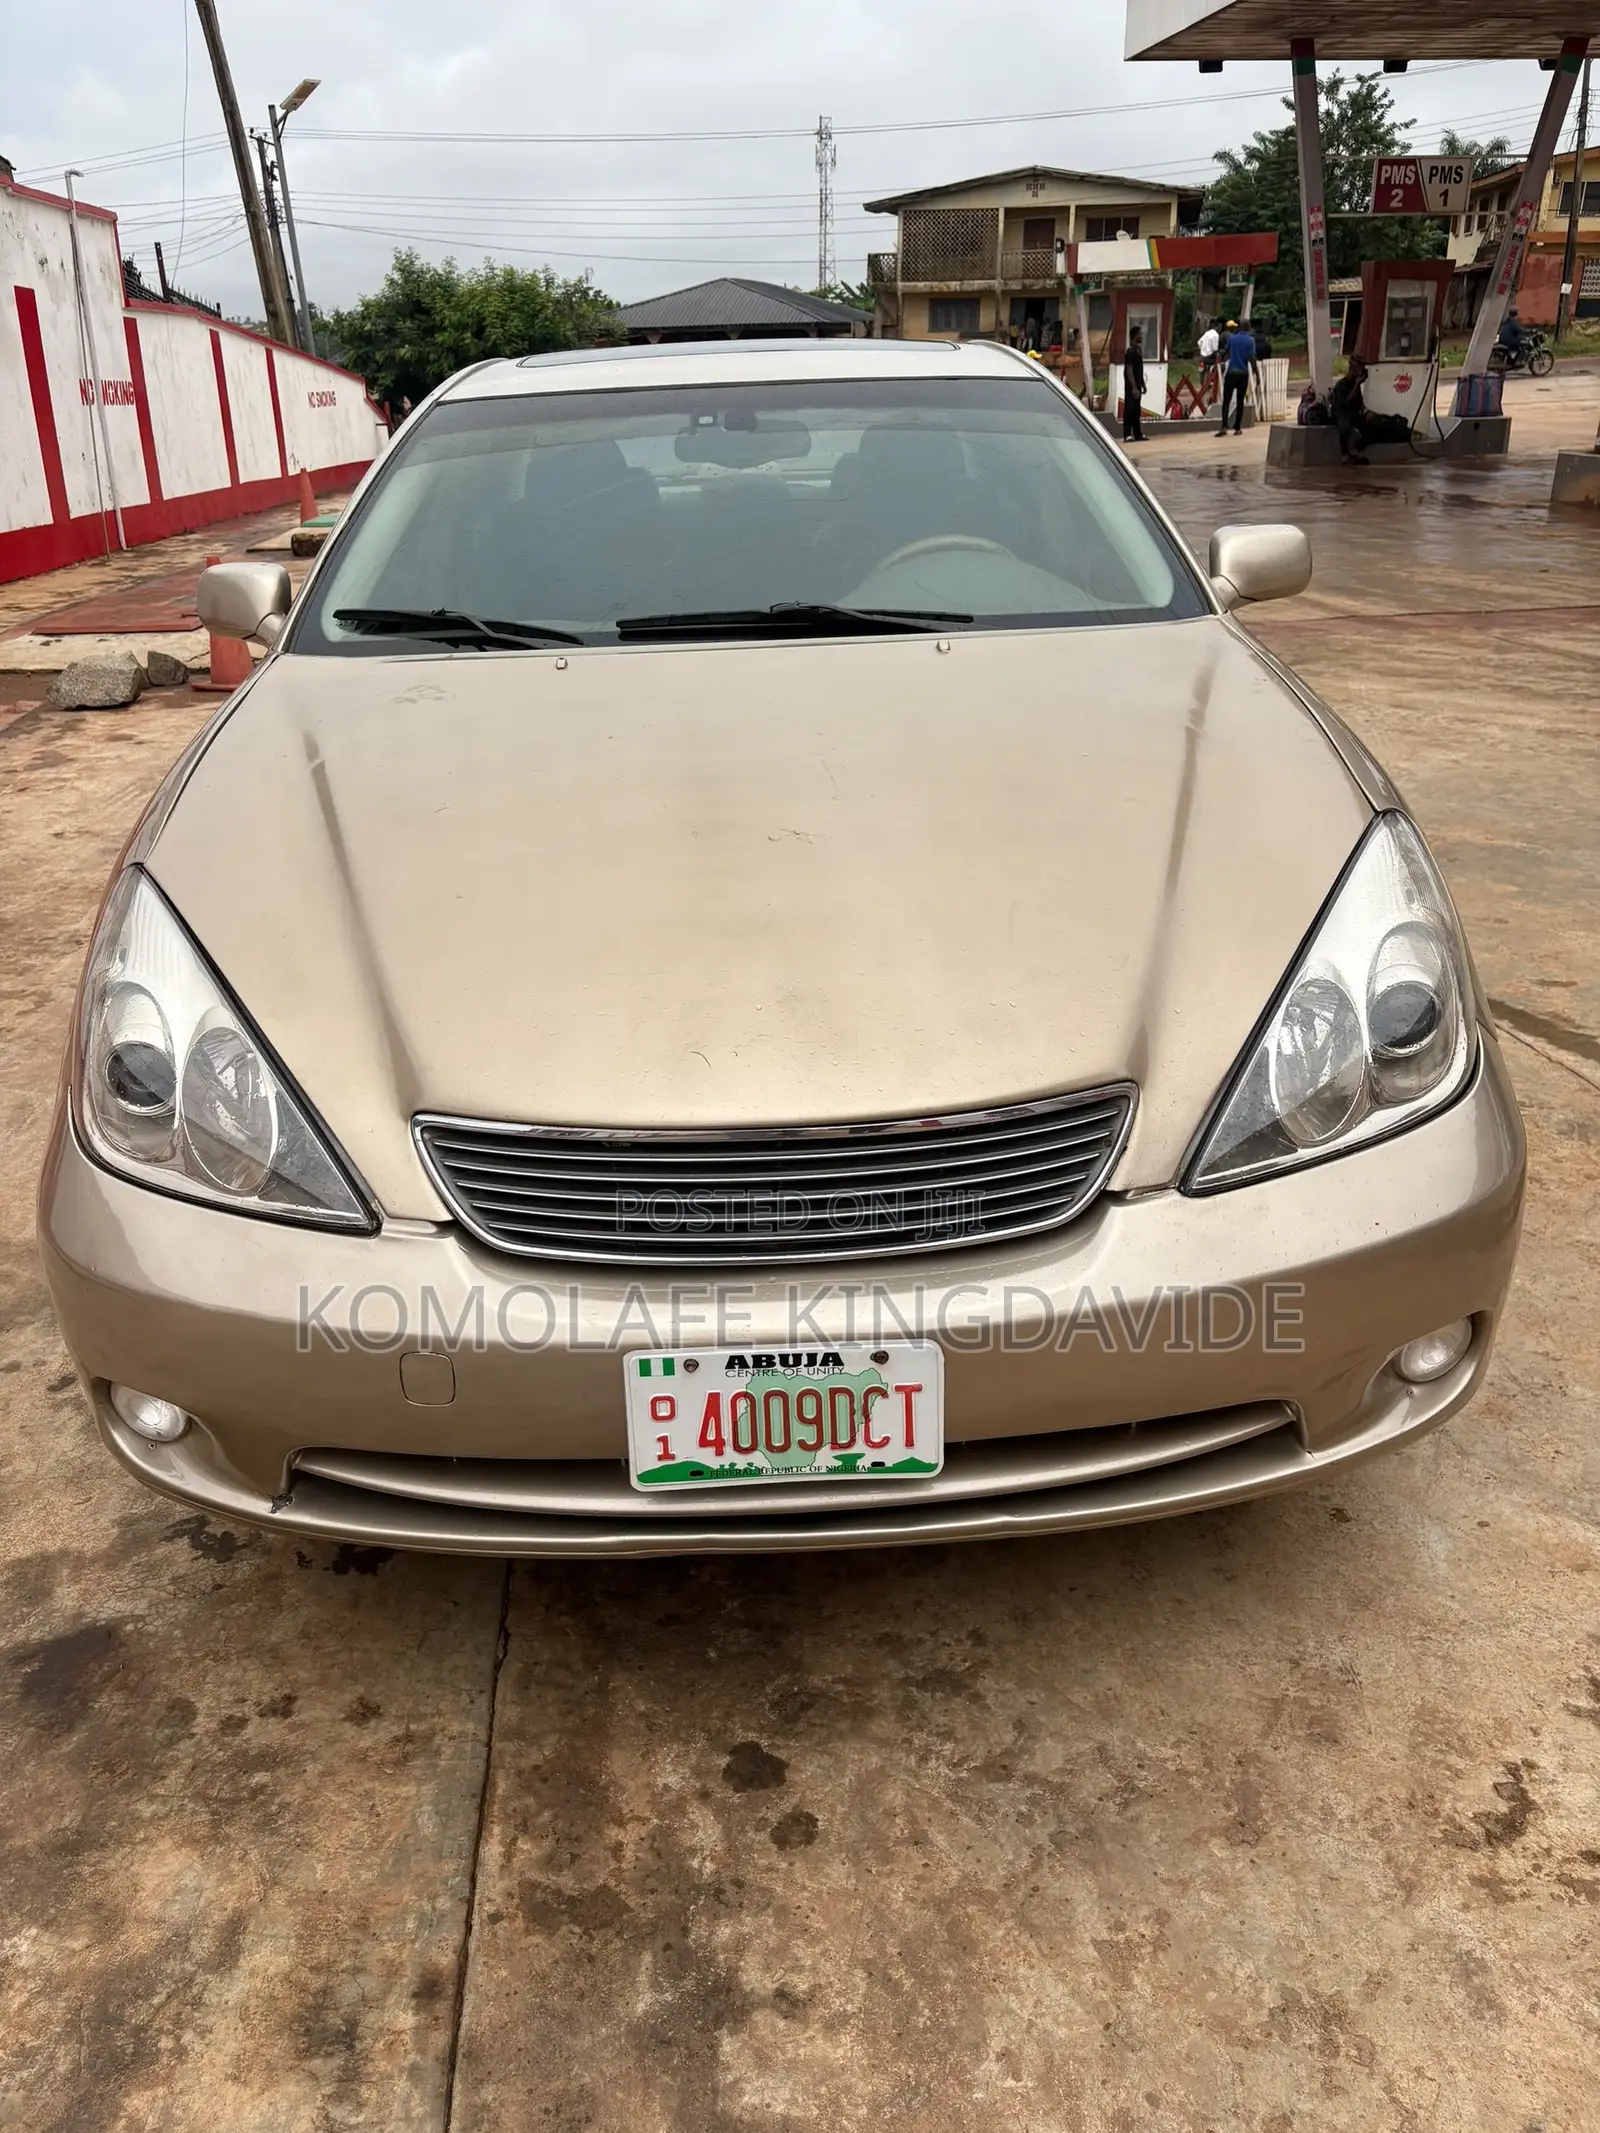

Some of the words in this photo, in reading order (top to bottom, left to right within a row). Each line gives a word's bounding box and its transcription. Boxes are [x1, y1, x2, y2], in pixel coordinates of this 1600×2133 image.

[1380, 165, 1416, 185] PMS
[1428, 165, 1464, 185] PMS
[1389, 188, 1404, 208] 2
[1439, 188, 1450, 208] 1
[99, 379, 135, 407] MOKING
[725, 1352, 845, 1369] ABUJA
[725, 1368, 779, 1378] CENTRE
[786, 1367, 804, 1377] OF
[807, 1366, 845, 1376] UNITY
[697, 1382, 924, 1456] 4009DCT
[758, 1466, 808, 1475] REPUBLIC
[809, 1465, 823, 1473] OF
[825, 1464, 867, 1473] NIGERIA
